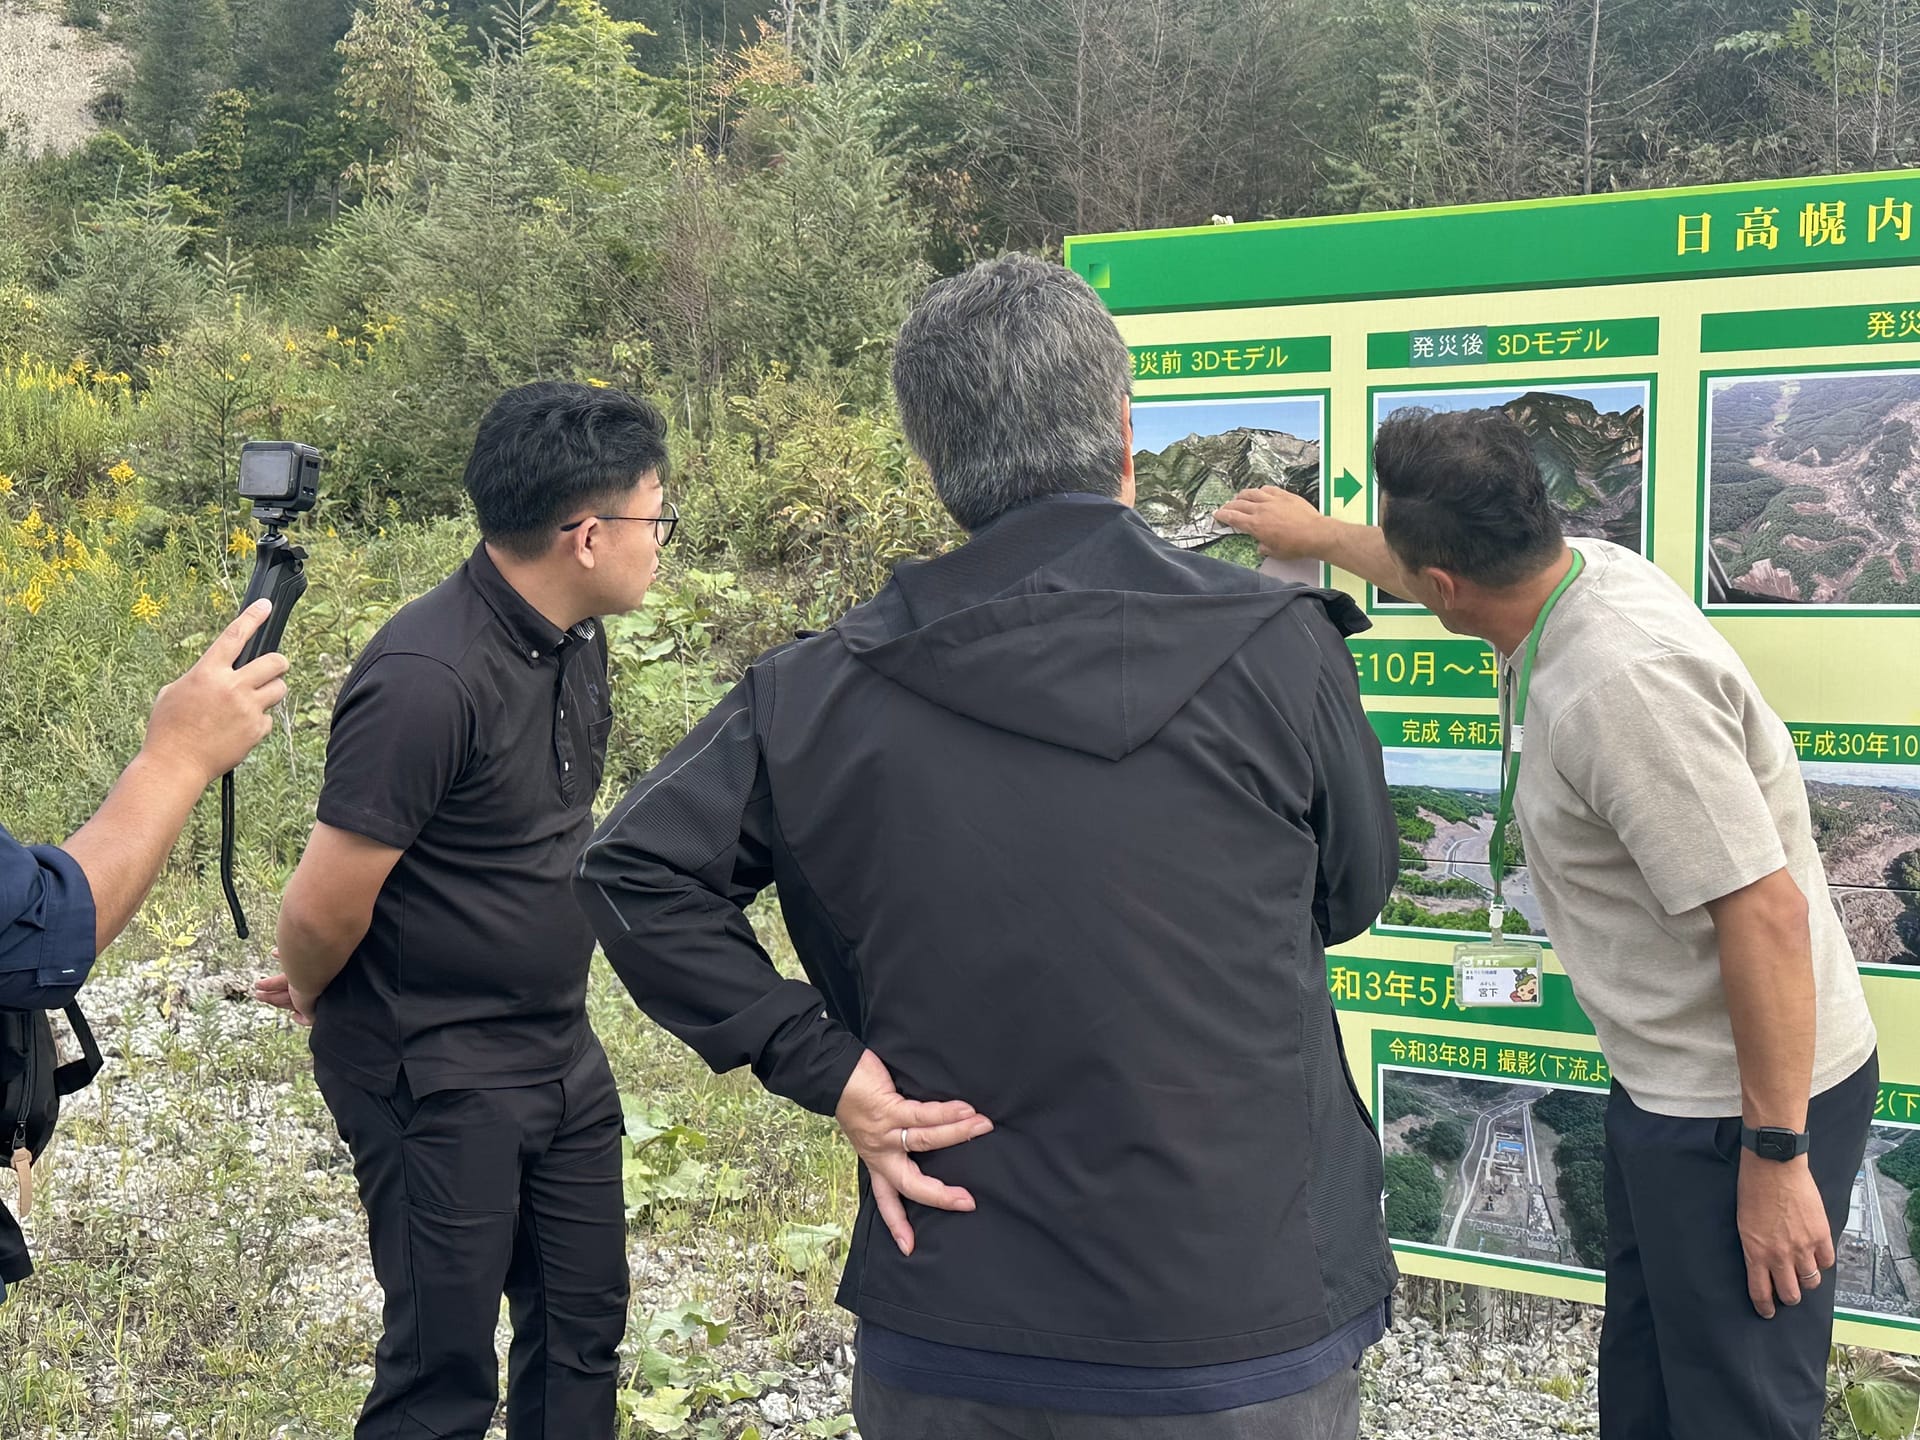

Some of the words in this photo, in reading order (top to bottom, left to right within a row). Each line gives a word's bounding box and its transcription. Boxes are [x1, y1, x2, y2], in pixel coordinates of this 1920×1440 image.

[1677, 197, 1913, 256] 日高幌内
[1867, 310, 1920, 339] 発災
[1191, 345, 1288, 371] 3Dモデル
[1413, 332, 1484, 359] 発災後
[1497, 328, 1609, 356] 3Dモデル
[1402, 719, 1440, 744] 完成
[1791, 730, 1919, 758] 平成30年10
[1388, 1037, 1487, 1069] 令和3年8月
[1497, 1048, 1613, 1083] 撮影(下流よ
